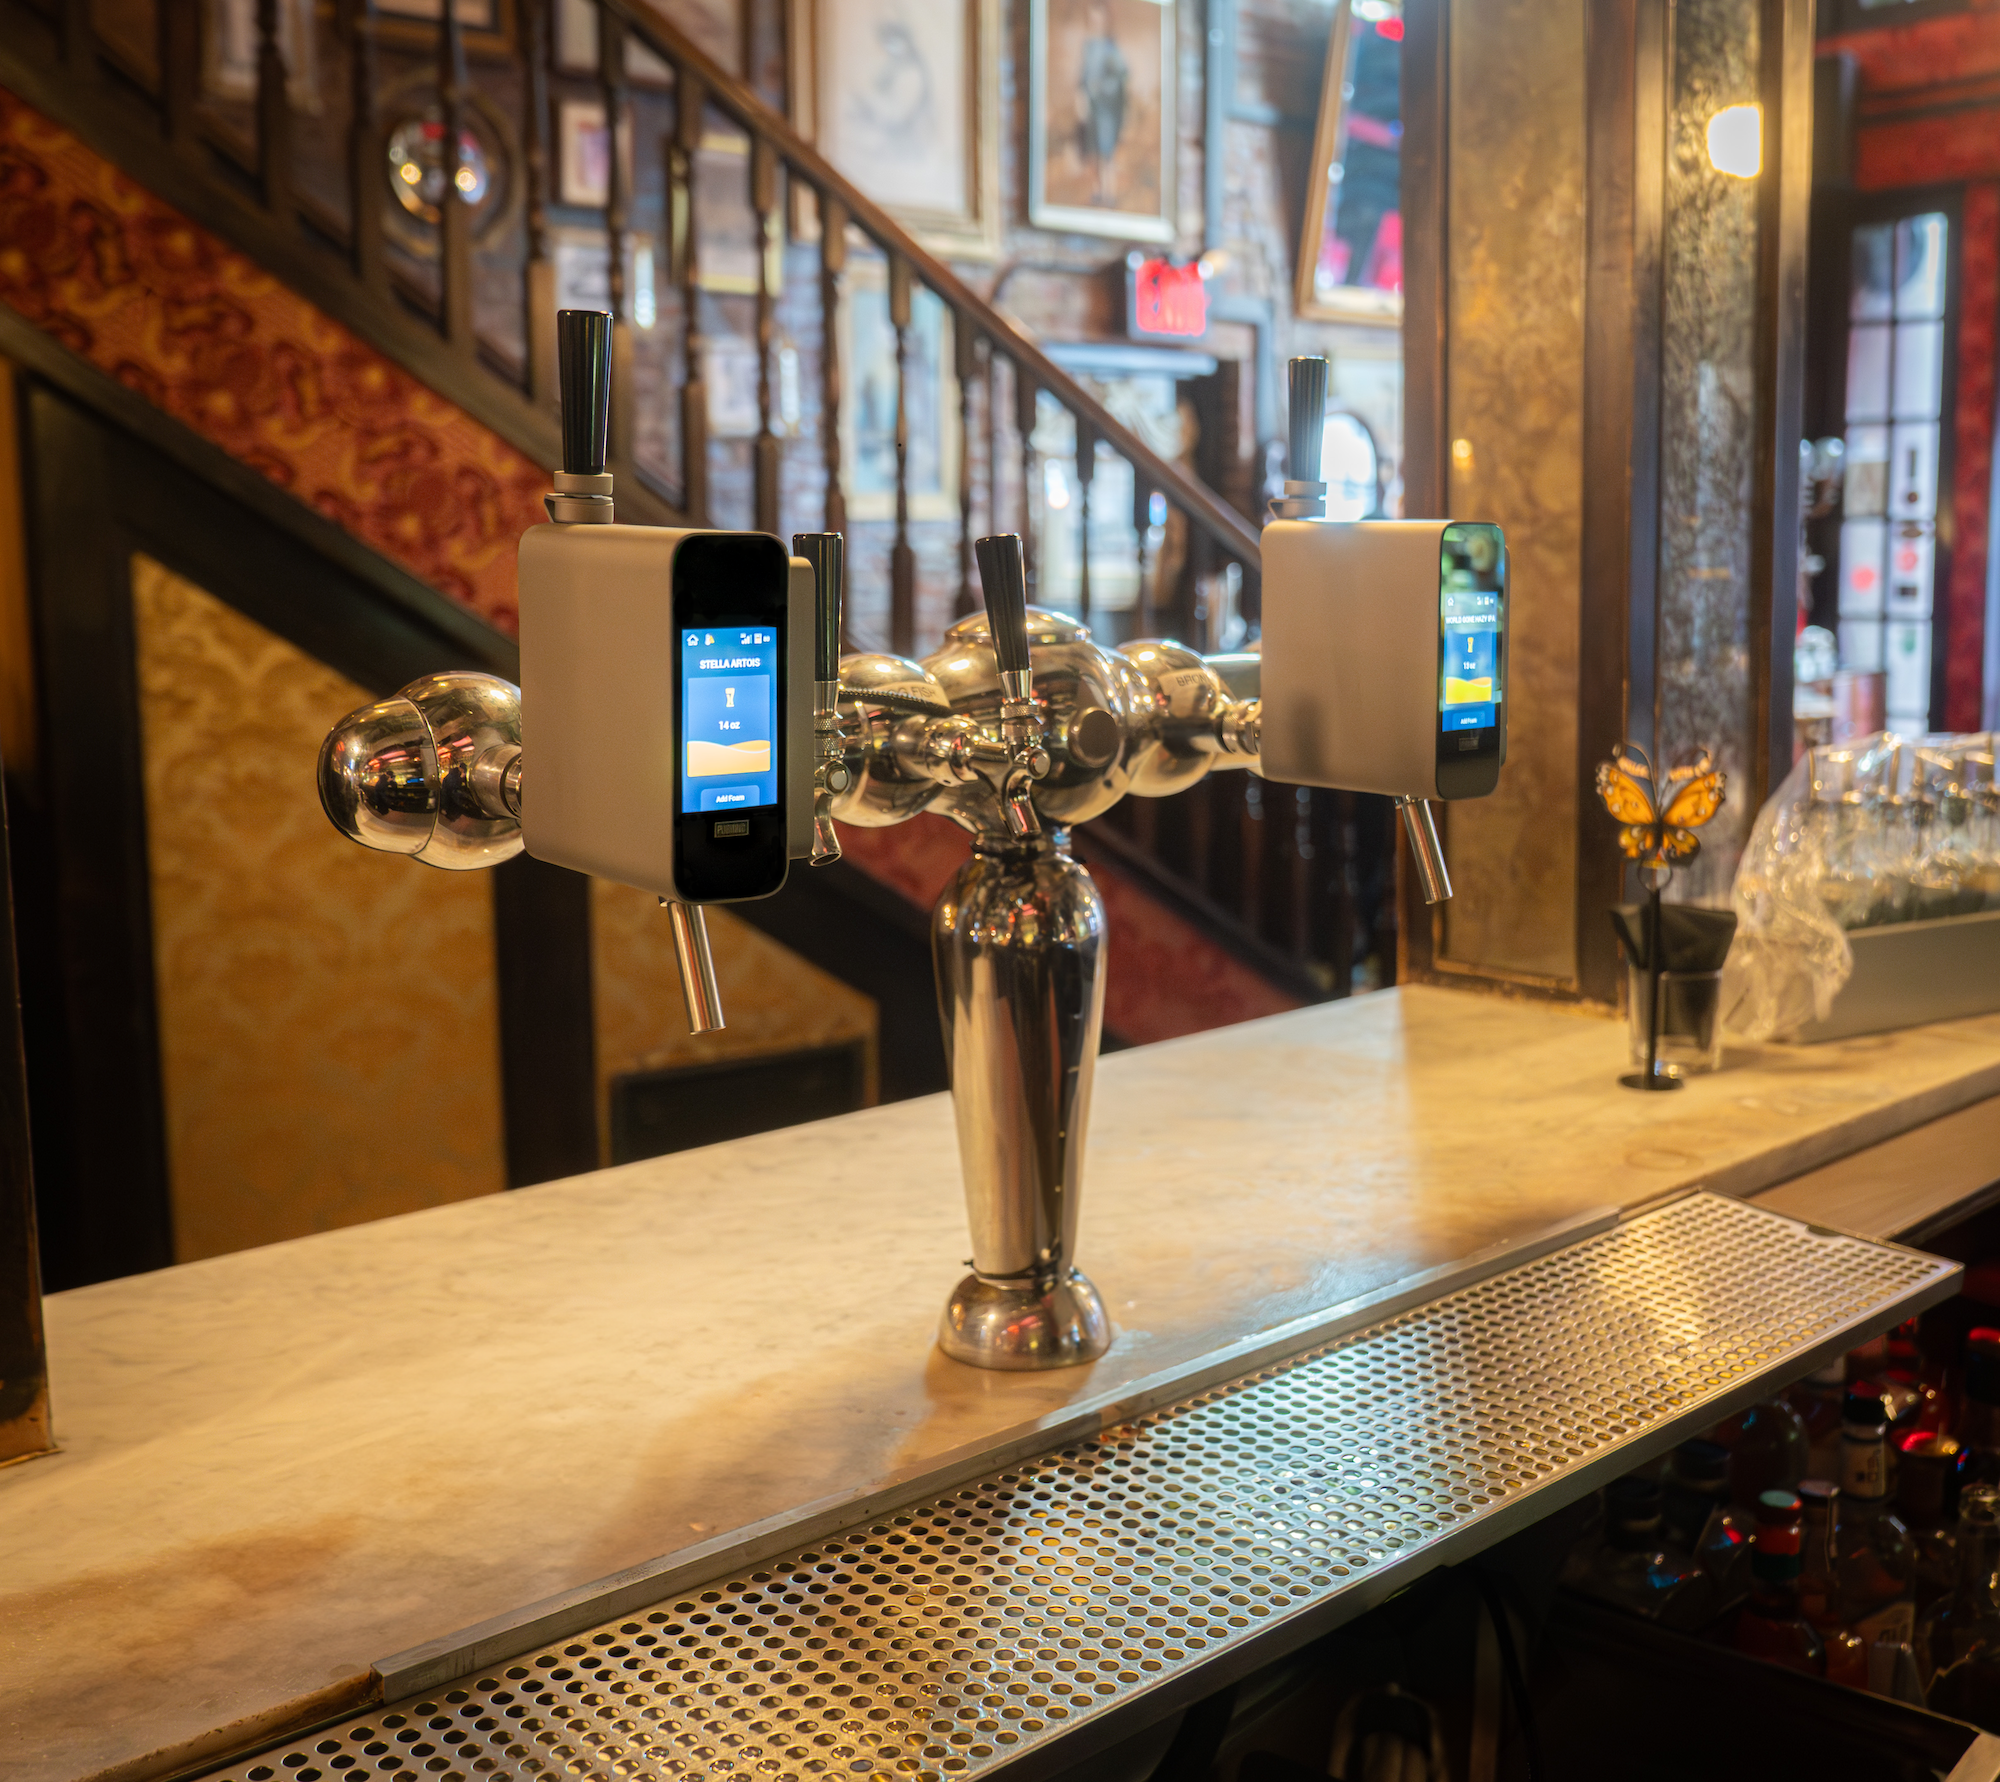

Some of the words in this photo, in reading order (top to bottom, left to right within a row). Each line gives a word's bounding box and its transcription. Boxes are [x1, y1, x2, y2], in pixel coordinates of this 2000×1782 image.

[1488, 614, 1496, 622] IPA
[699, 659, 729, 669] STELLA
[730, 658, 760, 668] ARTOIS
[719, 721, 729, 730] 14
[730, 721, 740, 730] oz
[729, 794, 745, 802] Foam
